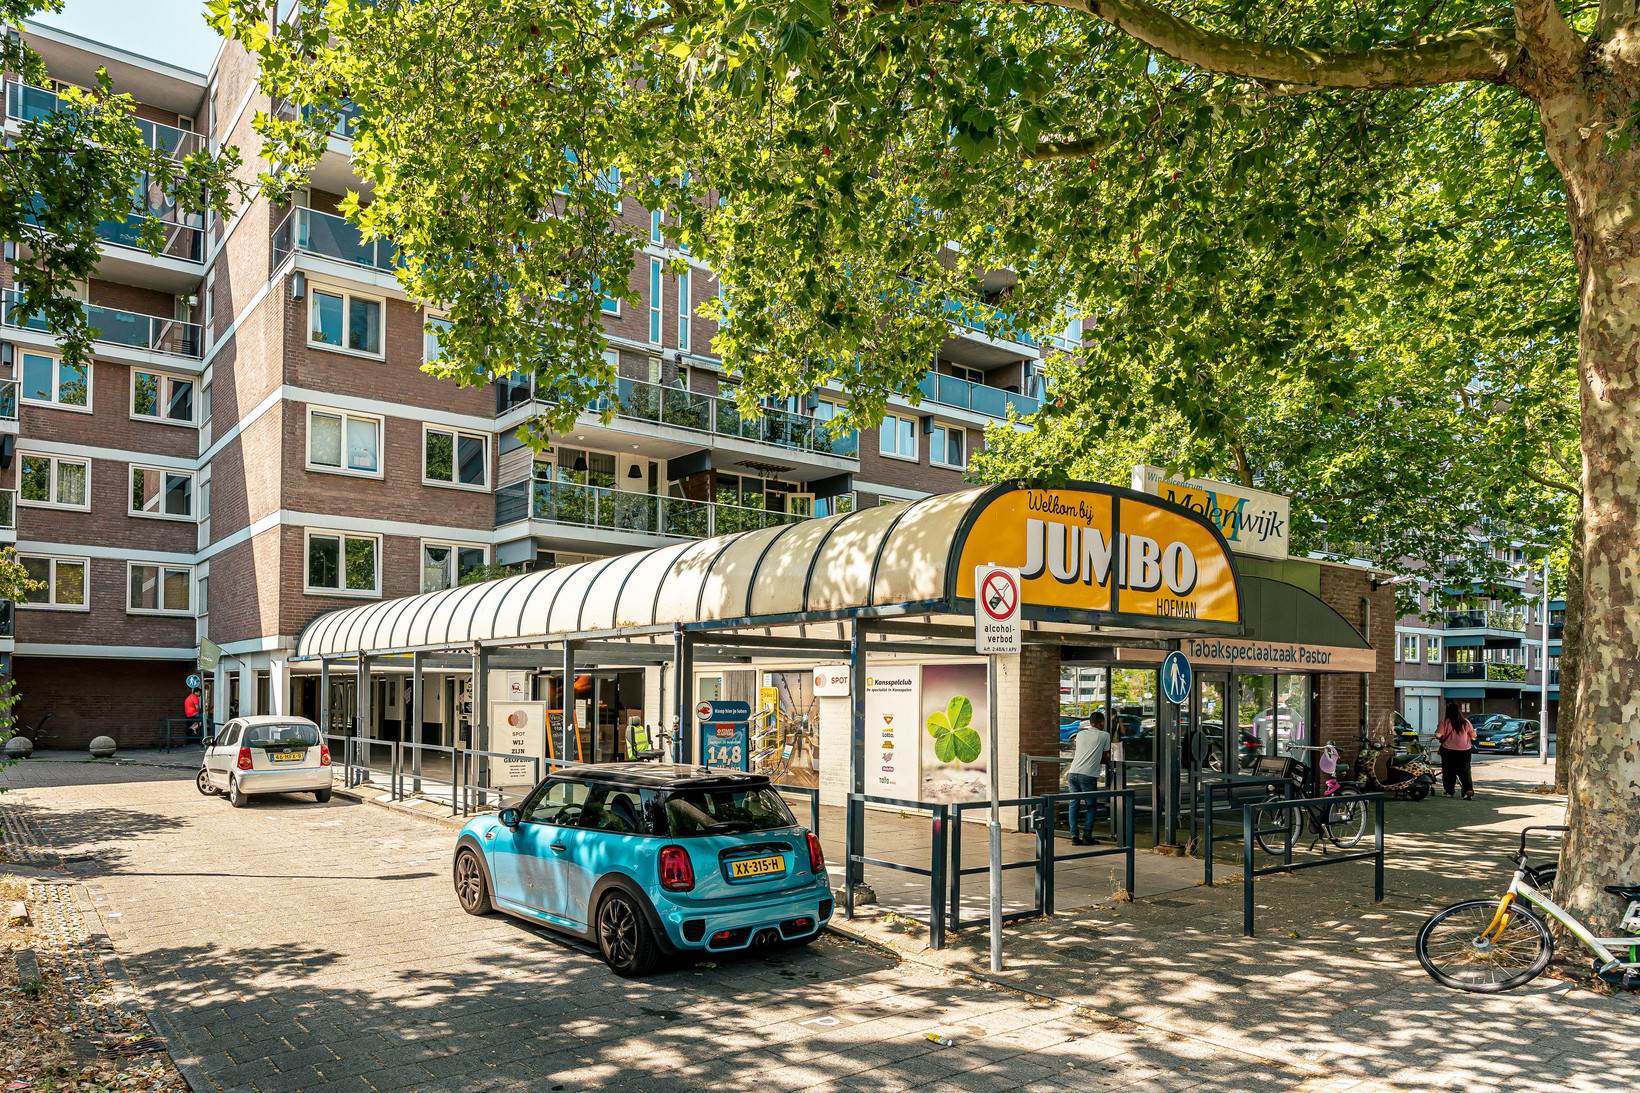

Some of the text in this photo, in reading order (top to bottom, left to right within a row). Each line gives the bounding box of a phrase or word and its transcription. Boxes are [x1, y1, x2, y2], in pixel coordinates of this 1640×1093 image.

[1147, 472, 1203, 491] Winkelcentrum
[1028, 491, 1095, 525] Welkom bij
[1166, 490, 1285, 542] Molenwijk
[1018, 518, 1198, 597] JUMBO
[1156, 598, 1197, 619] HOFMAN
[984, 624, 1015, 633] alcohol-
[987, 635, 1013, 643] verbod
[1187, 640, 1332, 665] Tabakspeciaalzaak Pastor
[874, 679, 912, 687] Kansspelclub
[708, 745, 742, 766] 14,8
[735, 858, 779, 875] XX-315-H
